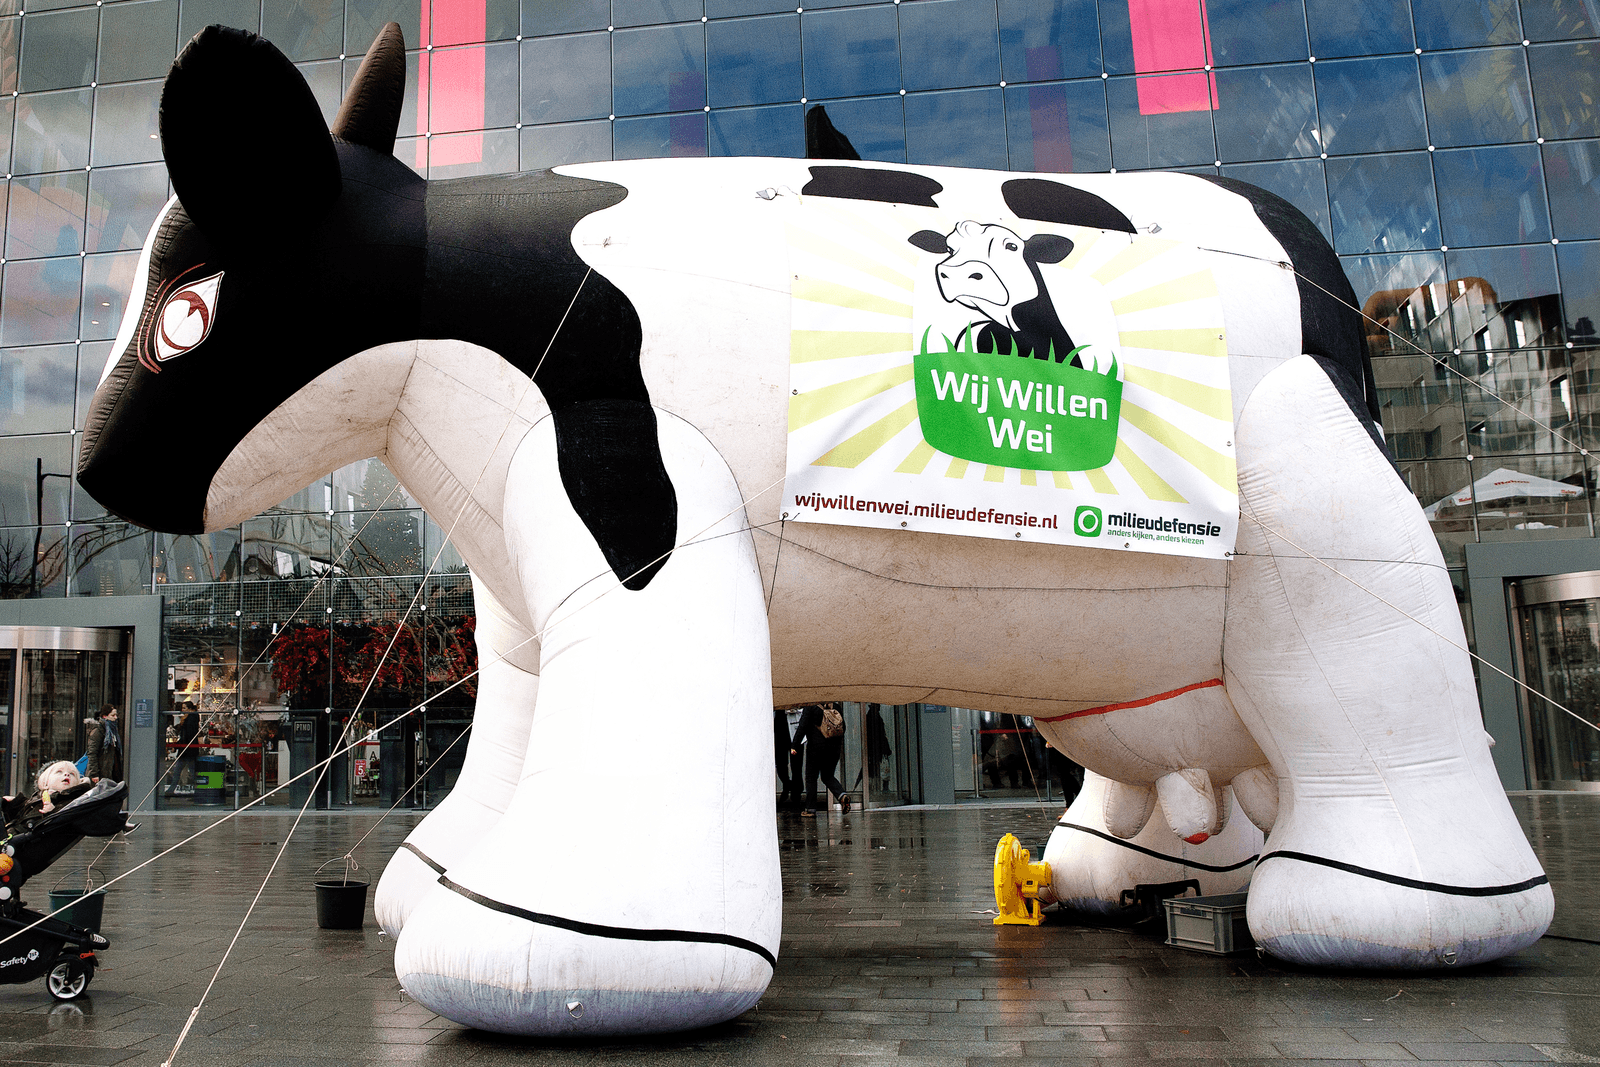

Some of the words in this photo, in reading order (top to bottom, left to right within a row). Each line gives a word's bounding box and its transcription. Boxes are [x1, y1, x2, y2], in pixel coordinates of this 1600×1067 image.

[931, 369, 988, 414] Wij
[996, 377, 1107, 420] Willen
[987, 417, 1052, 454] Wei
[795, 493, 1058, 529] wijwillenwei.milieudefensie.nl
[1108, 512, 1221, 536] milieudefensie
[1107, 529, 1131, 540] anders
[1132, 531, 1155, 541] kijken,
[1156, 534, 1180, 543] anders
[1181, 536, 1204, 545] kiezen
[0, 957, 28, 968] Safety
